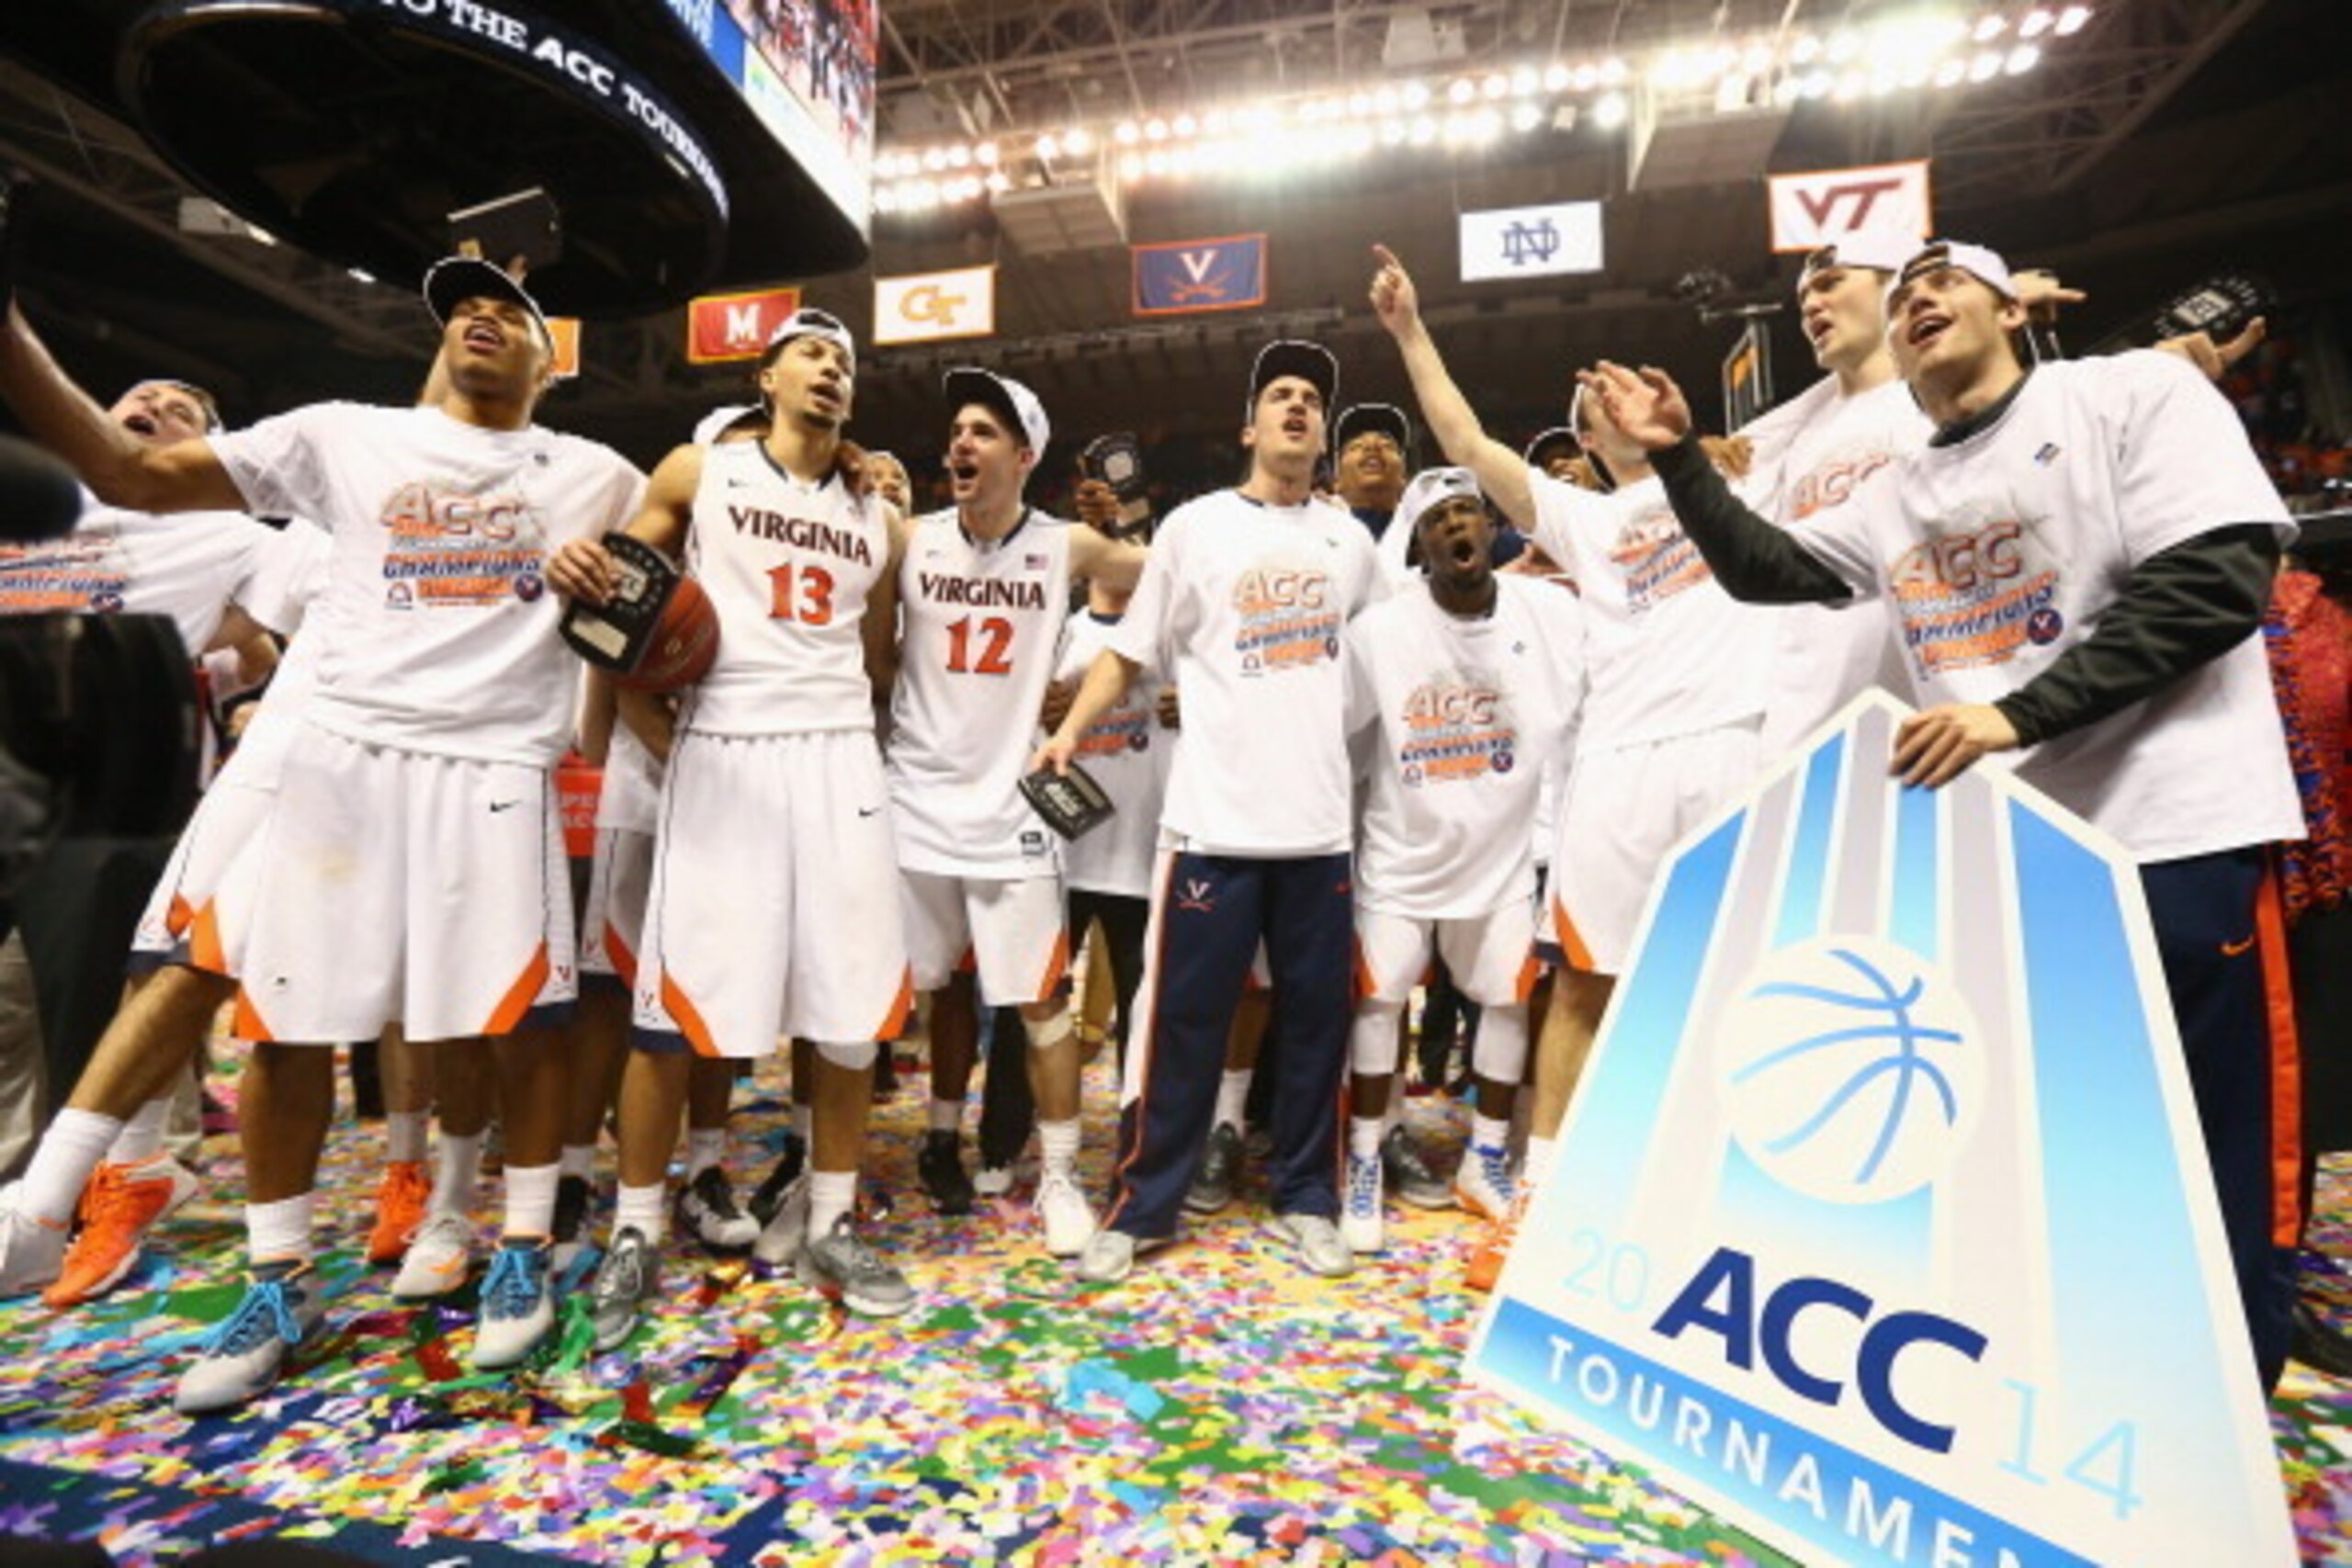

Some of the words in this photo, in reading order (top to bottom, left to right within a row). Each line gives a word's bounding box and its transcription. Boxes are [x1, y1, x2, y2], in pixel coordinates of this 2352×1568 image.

[443, 0, 528, 51] THE
[533, 38, 616, 96] ACC
[1794, 178, 1905, 231] VT
[1180, 248, 1217, 283] V
[724, 303, 762, 344] M
[728, 506, 872, 567] VIRGINIA
[1888, 520, 2022, 593] ACC
[765, 561, 834, 625] 13
[919, 572, 1046, 610] VIRGINIA
[1232, 570, 1329, 610] ACC
[945, 614, 1014, 674] 12
[1402, 683, 1499, 726] ACC
[1563, 1228, 1650, 1313] 20
[1650, 1246, 1989, 1455] ACC
[1995, 1377, 2143, 1521] 14
[1546, 1334, 2024, 1568] TOURNAME
